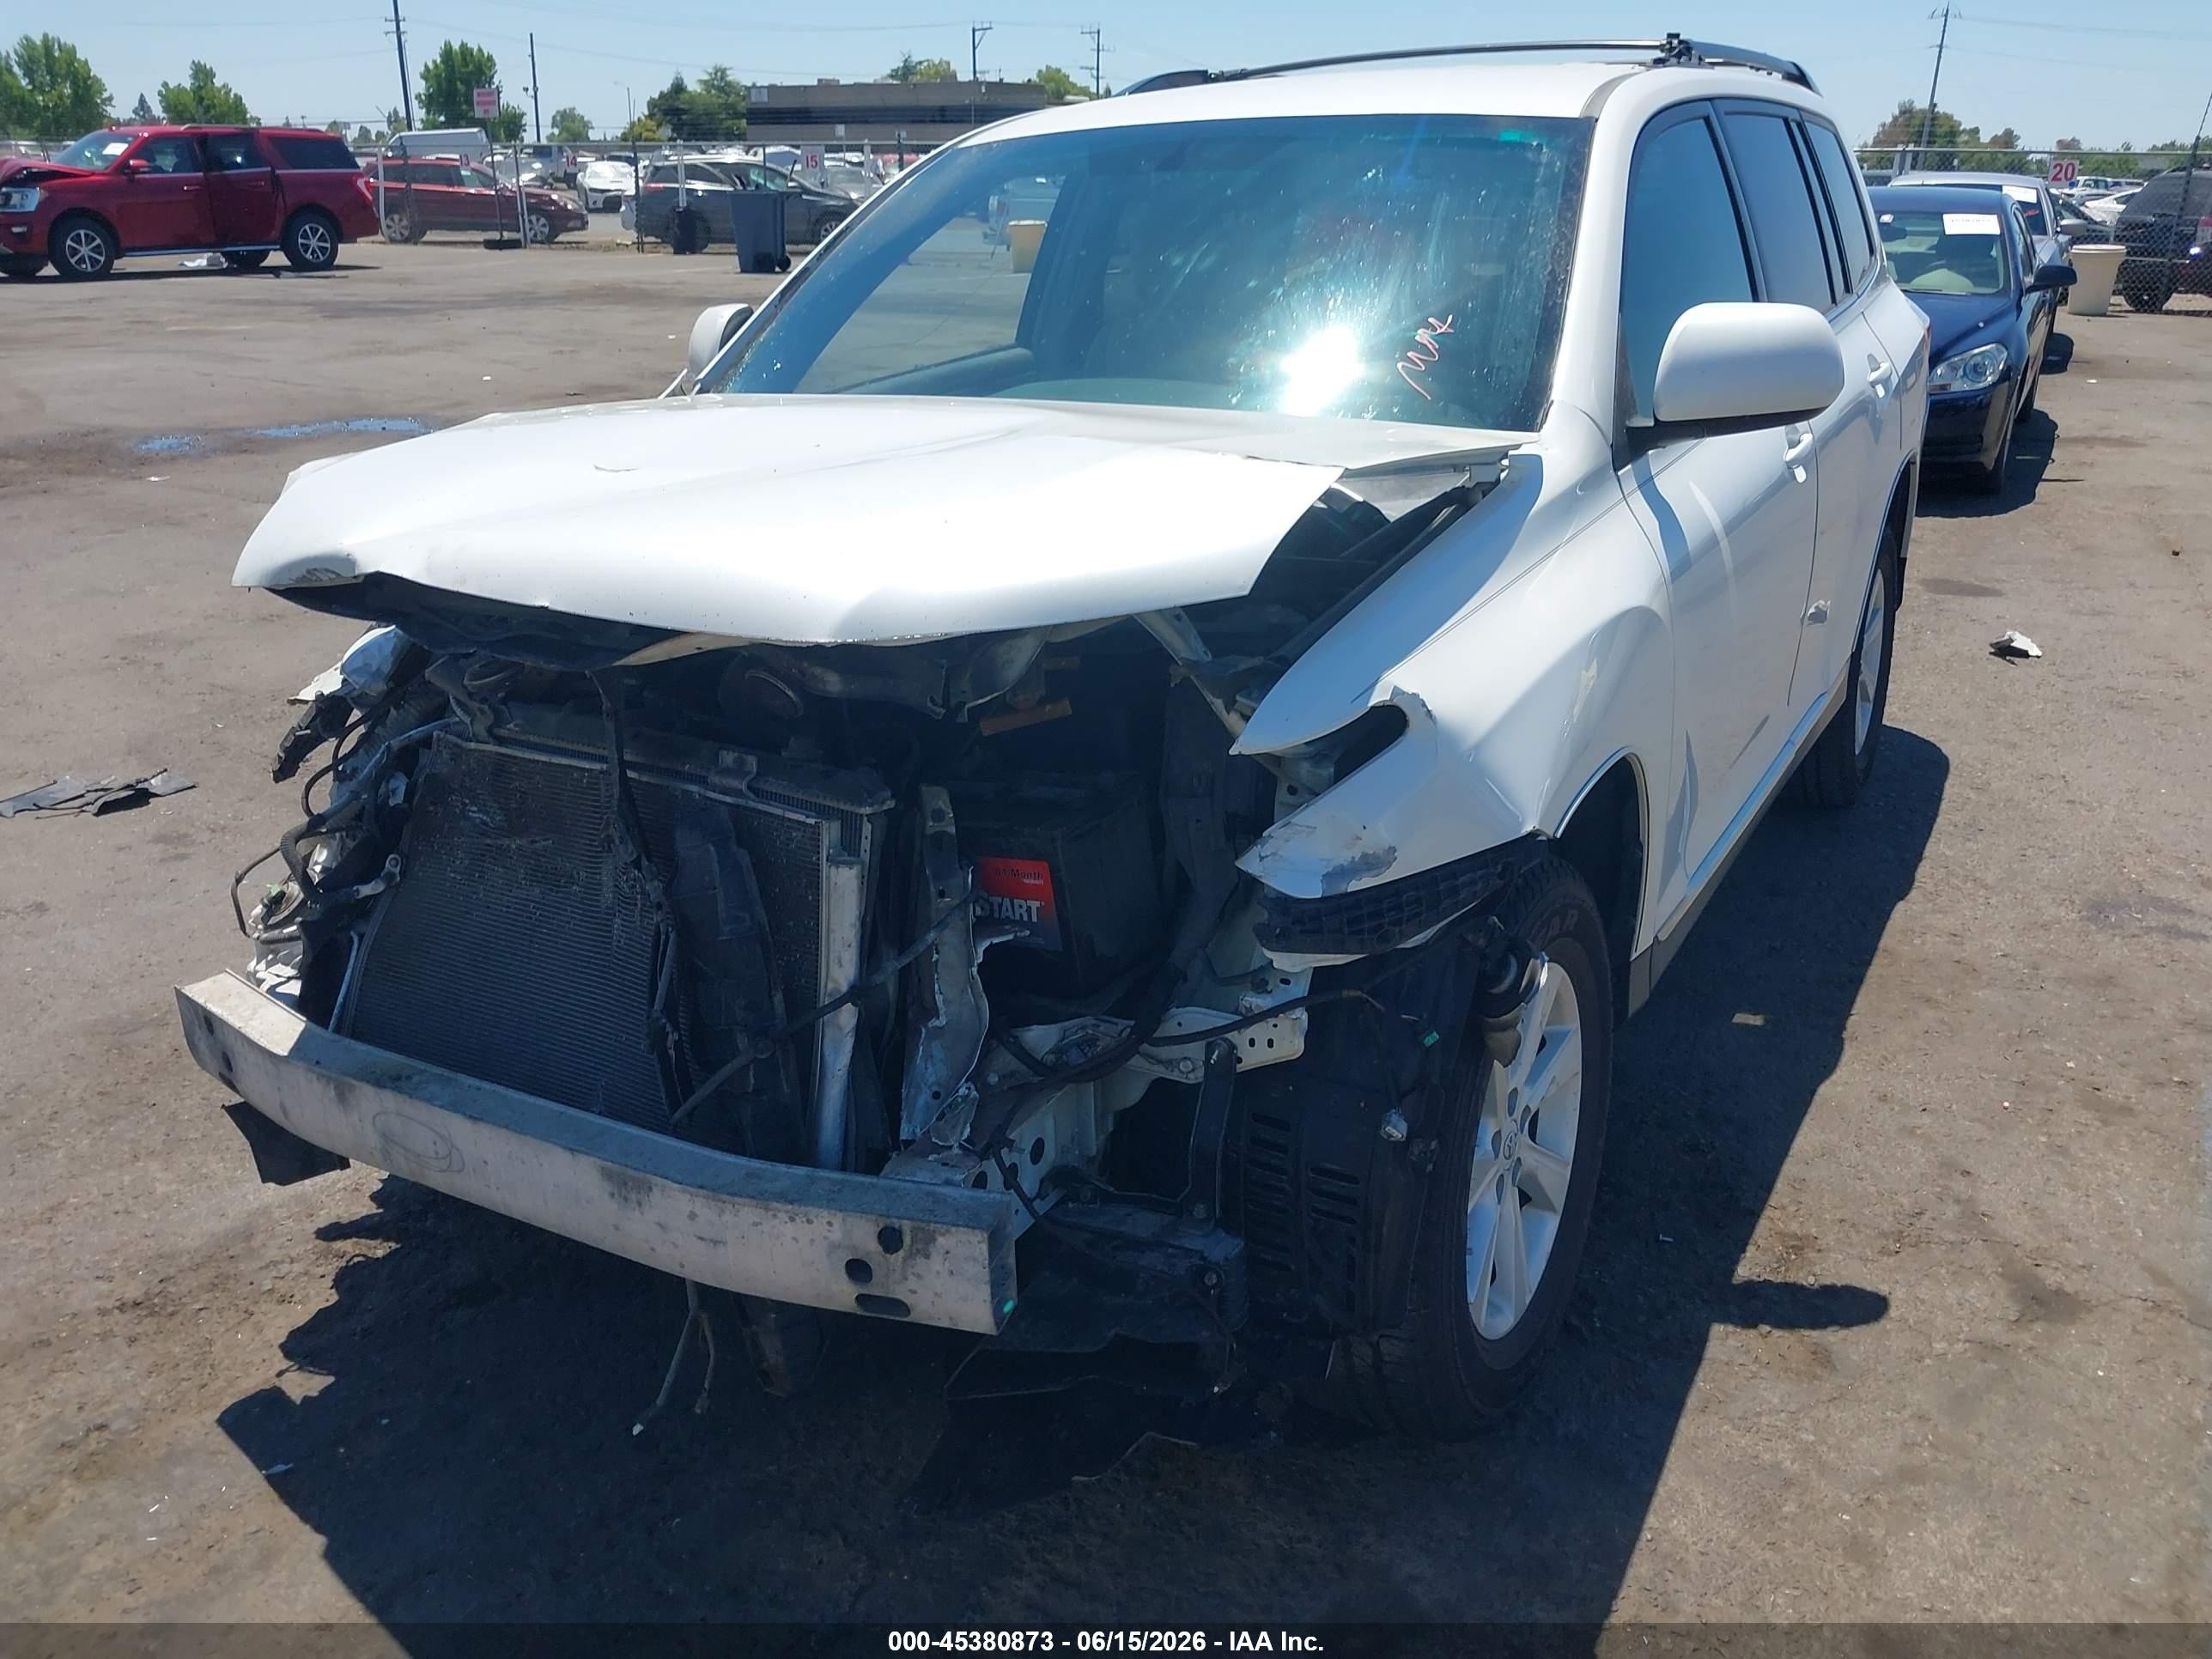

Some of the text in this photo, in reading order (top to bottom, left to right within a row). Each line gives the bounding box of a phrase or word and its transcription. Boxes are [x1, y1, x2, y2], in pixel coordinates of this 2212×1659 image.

[459, 154, 470, 167] 13
[565, 155, 578, 167] 14
[805, 155, 817, 168] 15
[2051, 162, 2076, 182] 20
